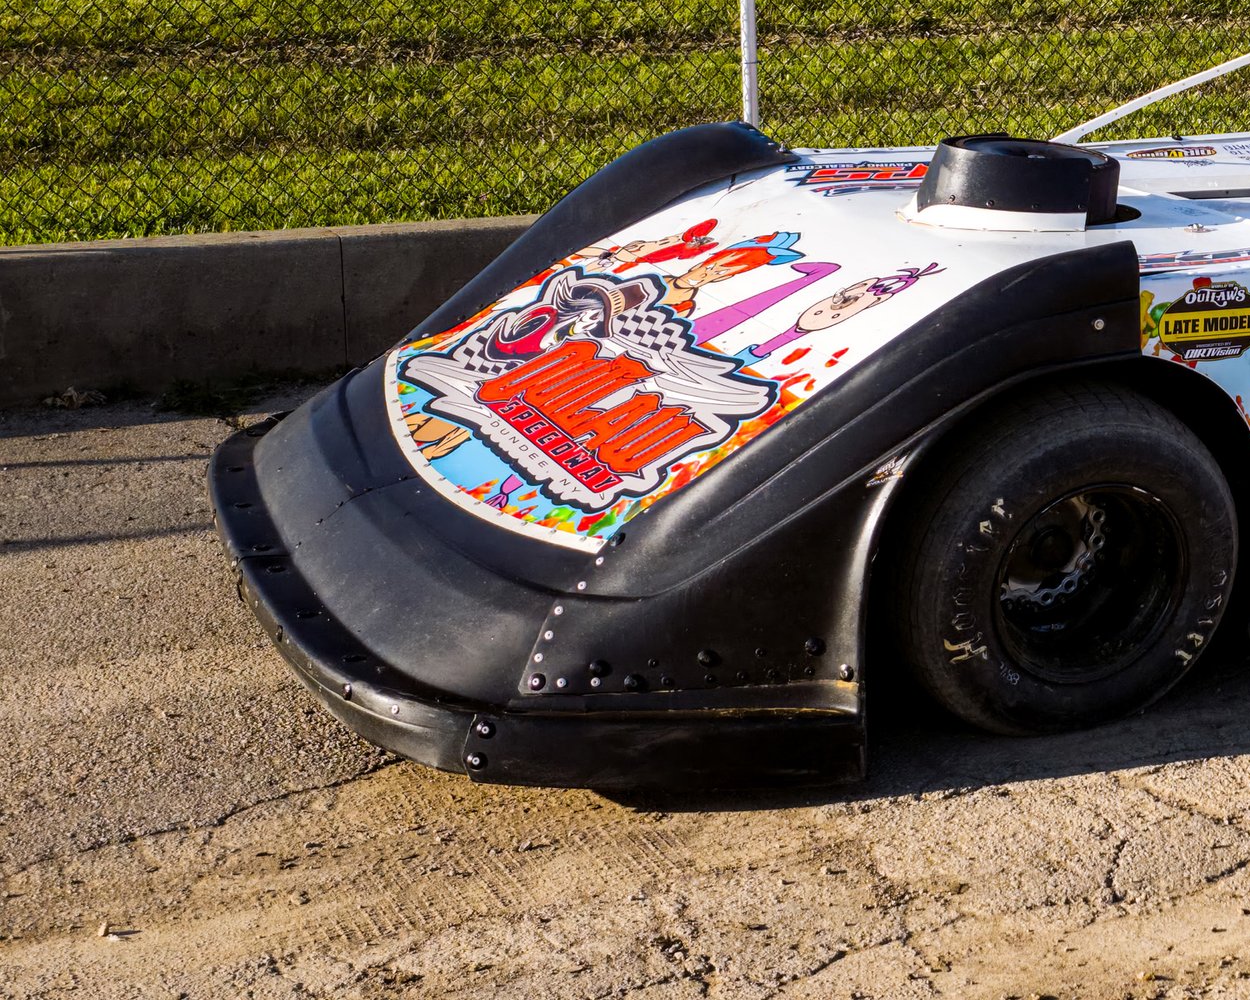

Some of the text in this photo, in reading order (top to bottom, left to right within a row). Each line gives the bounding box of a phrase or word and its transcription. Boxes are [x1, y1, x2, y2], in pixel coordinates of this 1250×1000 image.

[1164, 319, 1200, 335] LATE
[1184, 346, 1242, 359] DIRTVision
[499, 399, 619, 490] SPEEDWAY
[560, 478, 582, 493] NY
